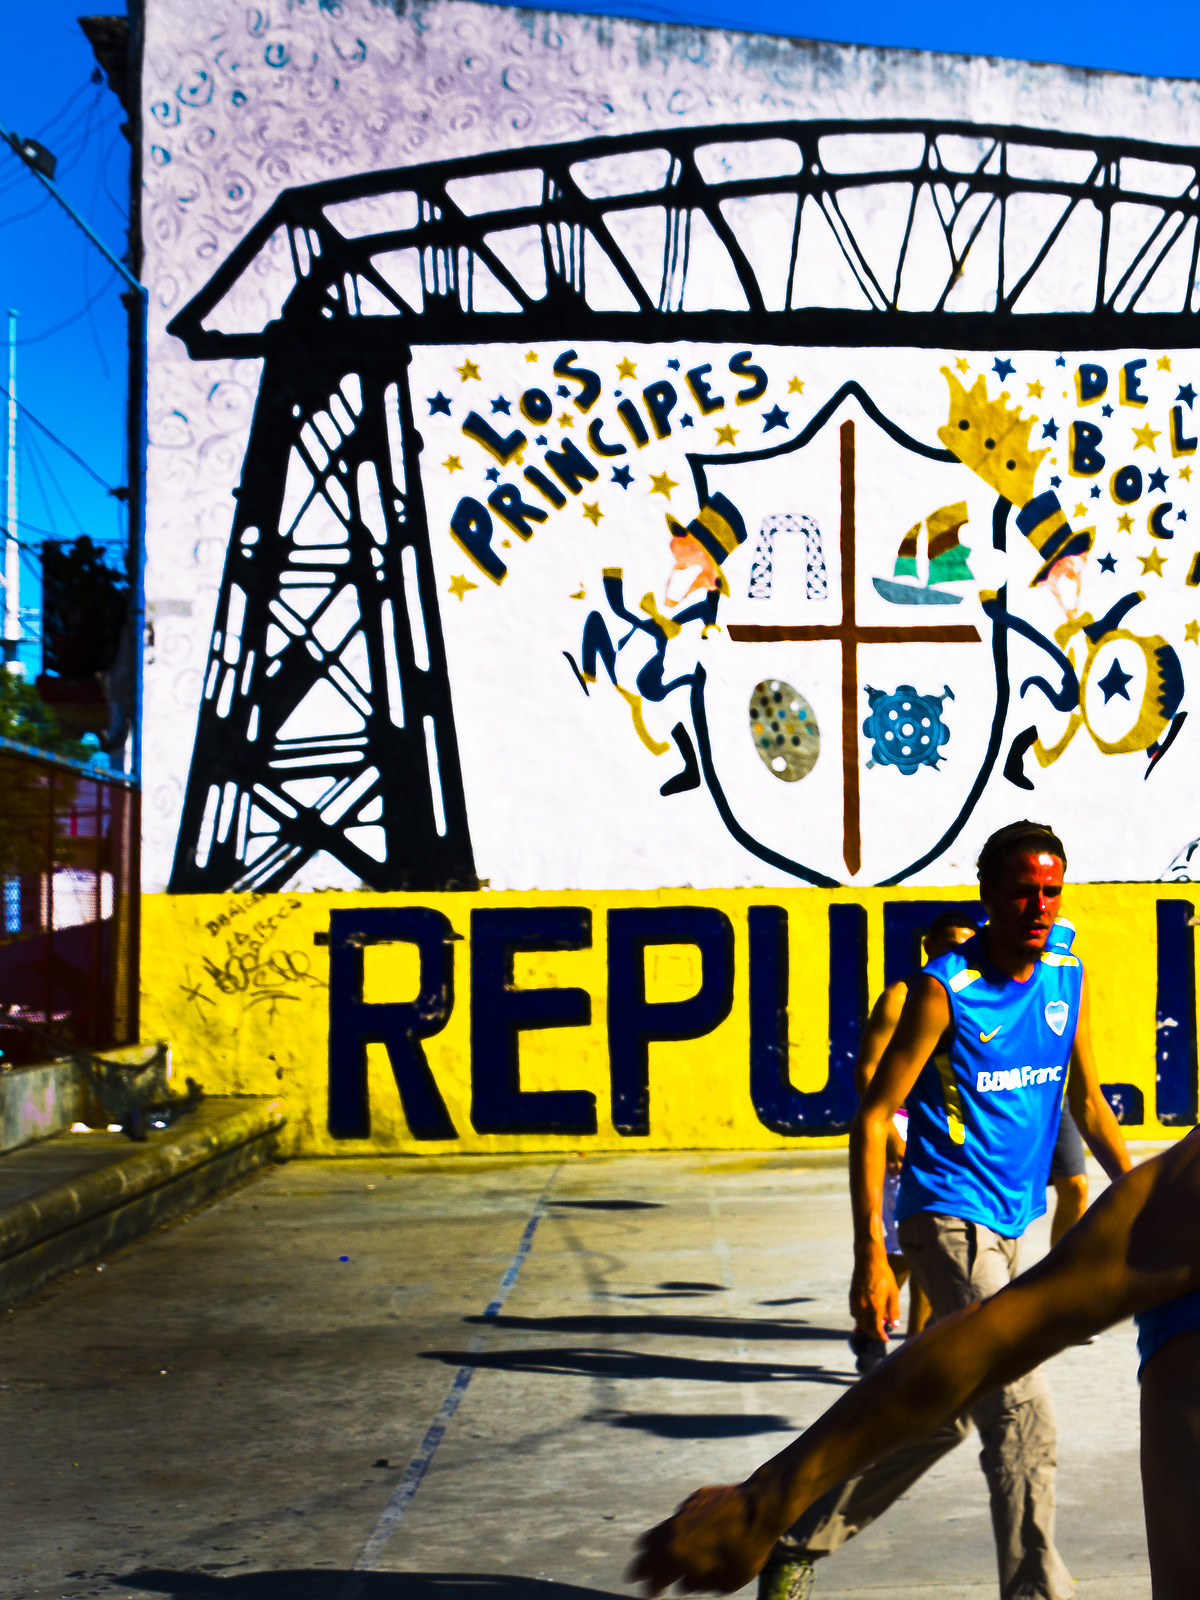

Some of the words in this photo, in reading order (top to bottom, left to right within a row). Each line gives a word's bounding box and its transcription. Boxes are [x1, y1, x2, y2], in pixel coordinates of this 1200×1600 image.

[462, 349, 601, 466] LOS
[1074, 358, 1149, 408] DE
[449, 350, 768, 586] PRINCIPES
